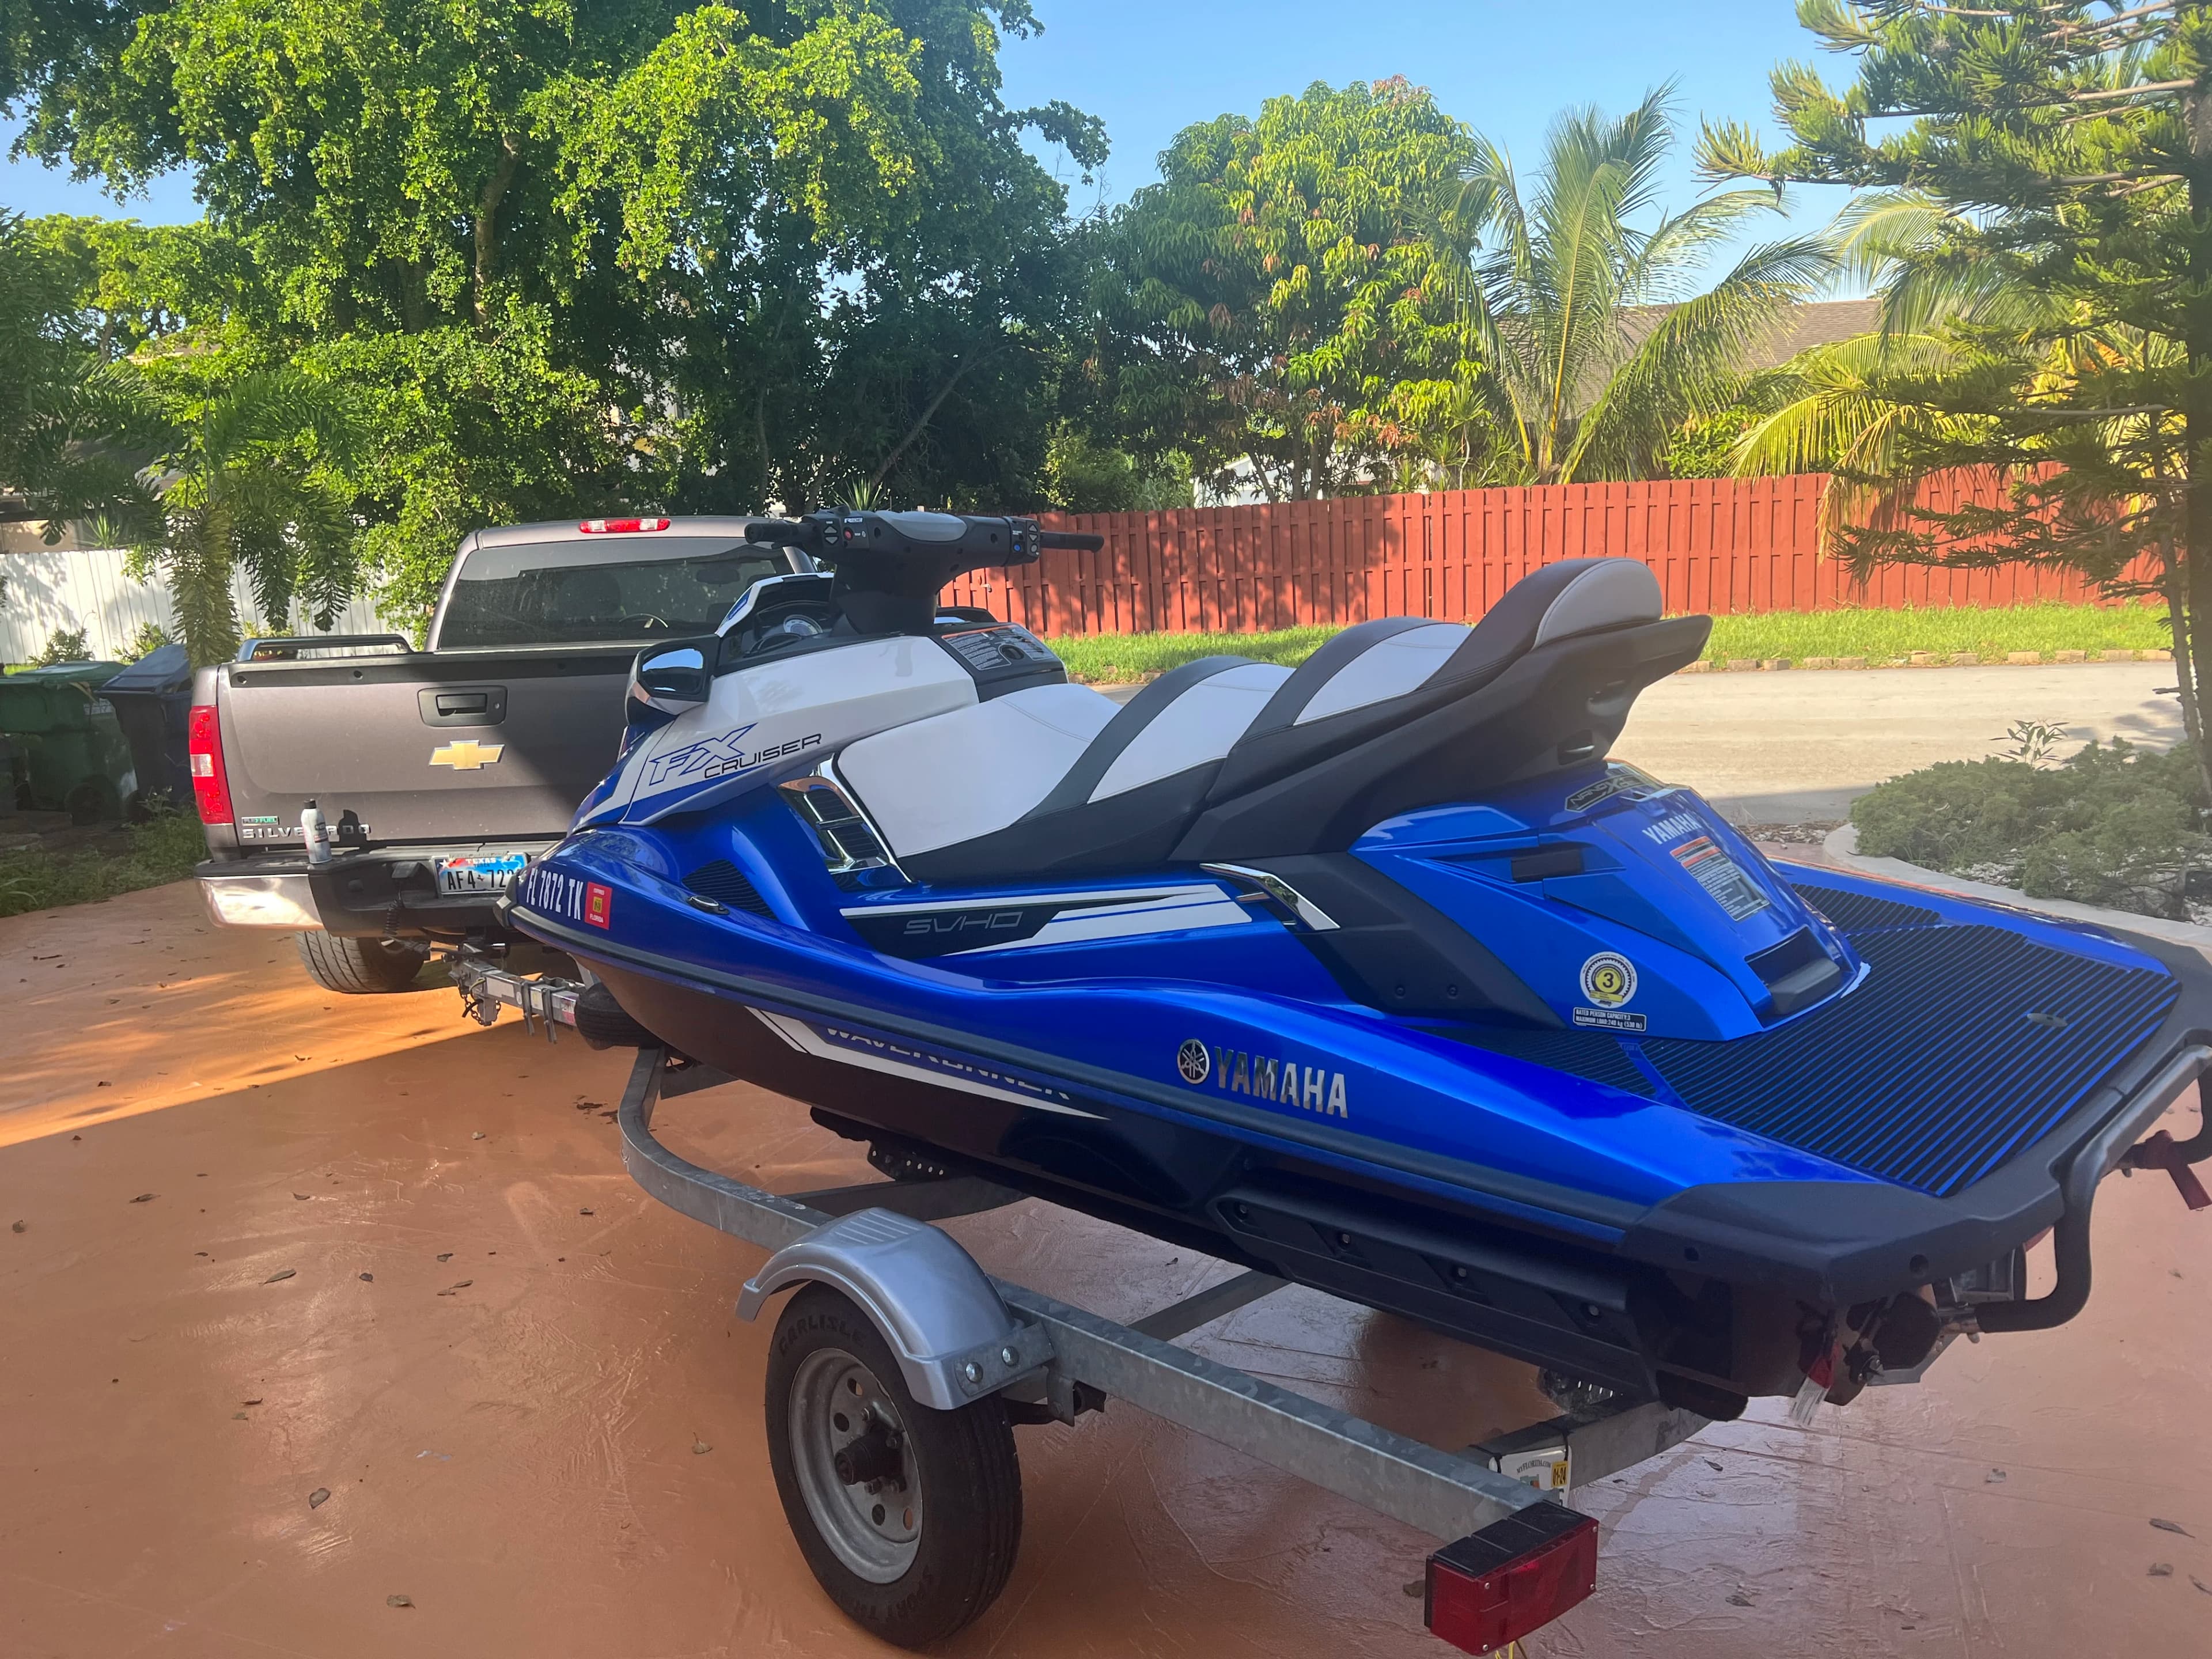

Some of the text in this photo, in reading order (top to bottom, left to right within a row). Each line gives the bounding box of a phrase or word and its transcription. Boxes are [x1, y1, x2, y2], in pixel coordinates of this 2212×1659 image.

[649, 722, 759, 786] FX
[704, 733, 822, 778] CRUISER
[243, 824, 370, 839] SILVEADO
[1642, 813, 1703, 845] YAMAHA
[447, 870, 476, 890] AF4
[526, 868, 584, 921] FL 7872 TK
[1603, 972, 1614, 988] 3
[1214, 1046, 1348, 1119] YAMAHA
[779, 1314, 865, 1357] CARLISLE
